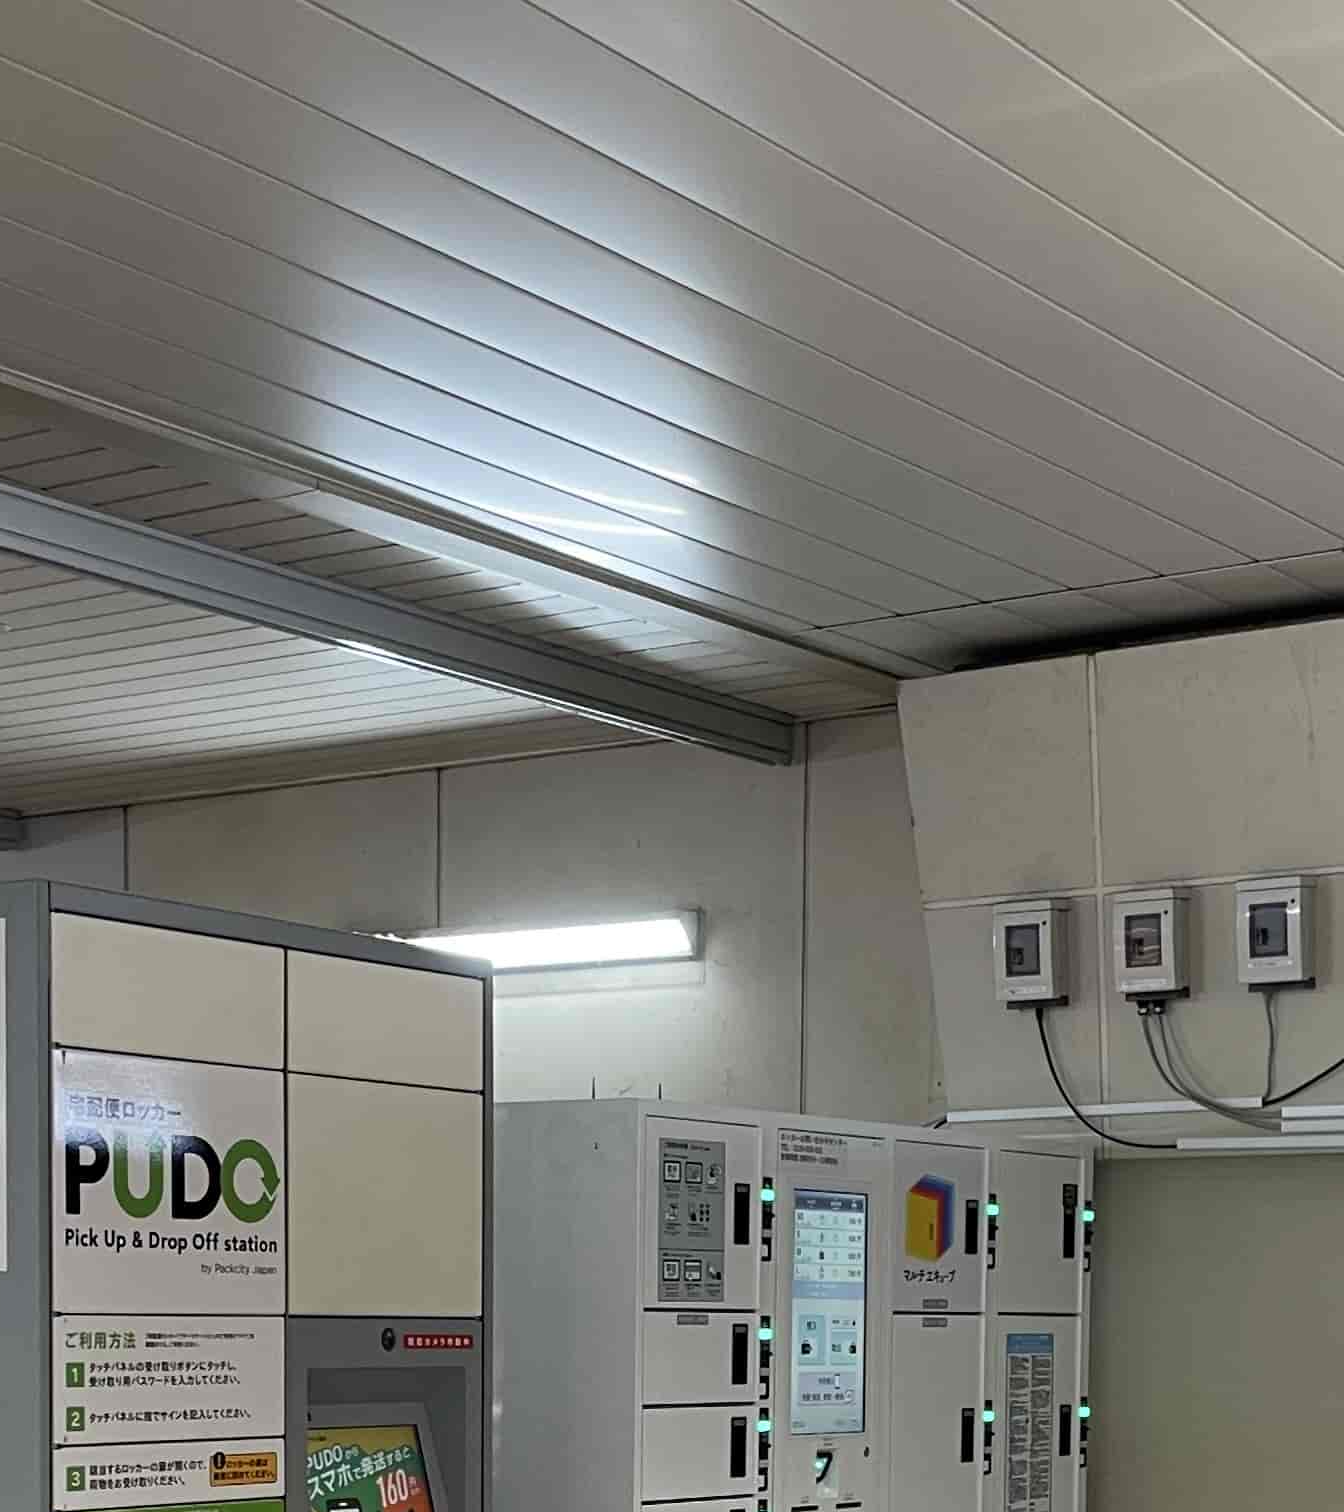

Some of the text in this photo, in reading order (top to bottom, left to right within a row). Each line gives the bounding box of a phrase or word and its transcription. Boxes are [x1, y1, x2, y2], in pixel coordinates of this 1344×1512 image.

[64, 1129, 281, 1224] PUDO
[64, 1227, 278, 1255] Pick Up & Drop Off station
[65, 1332, 137, 1350] ご利用方法
